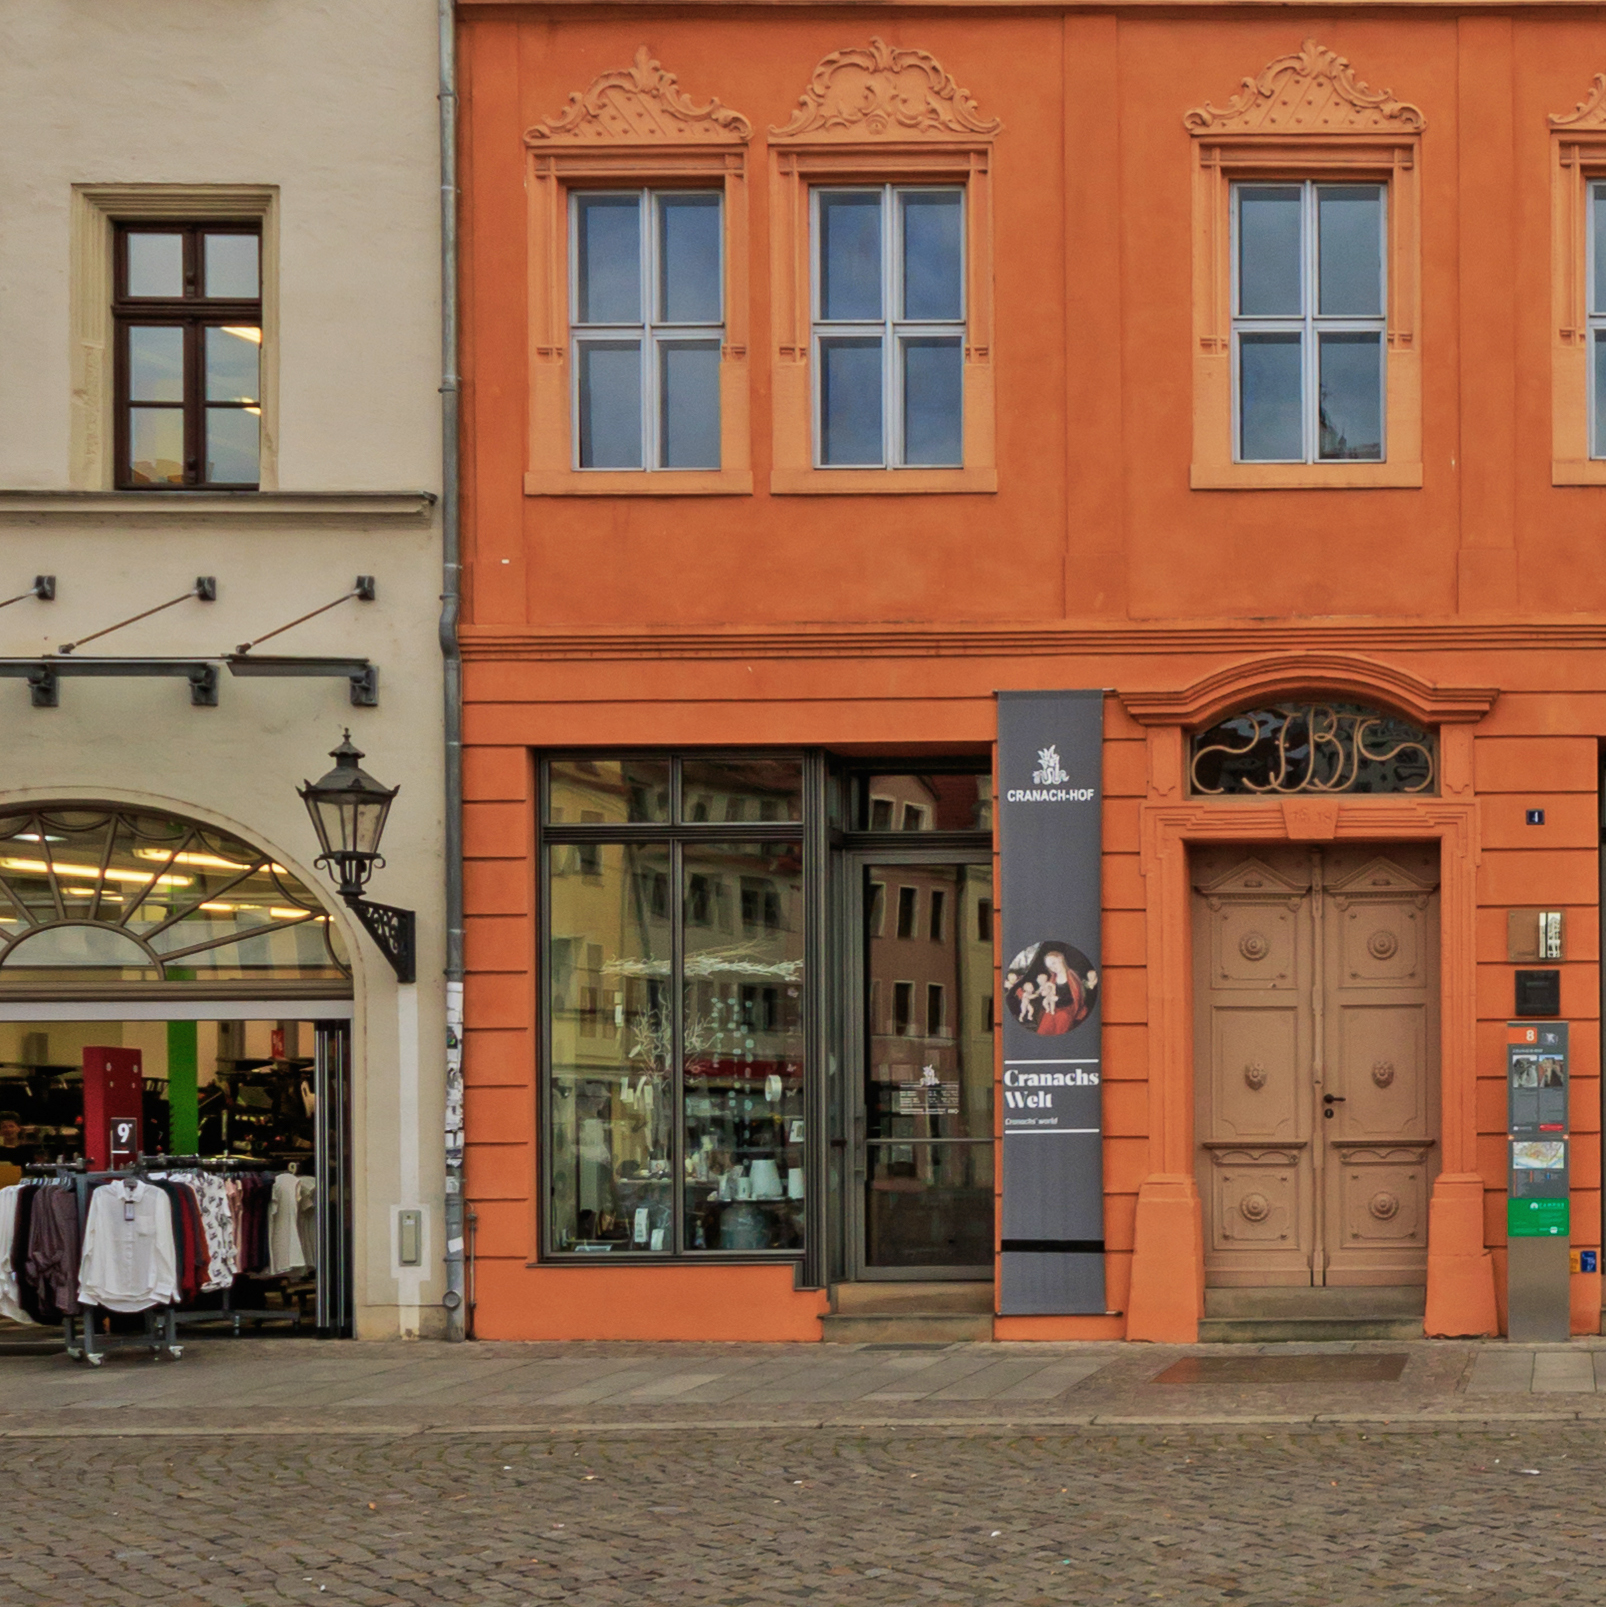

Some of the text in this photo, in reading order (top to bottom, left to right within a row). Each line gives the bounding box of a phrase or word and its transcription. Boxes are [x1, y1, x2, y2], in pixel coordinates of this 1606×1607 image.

[1007, 789, 1095, 802] CRANACH-HOF
[1531, 811, 1539, 823] 4
[1526, 1029, 1535, 1042] 8
[1004, 1068, 1100, 1087] Cranachs
[1004, 1090, 1053, 1109] Welt
